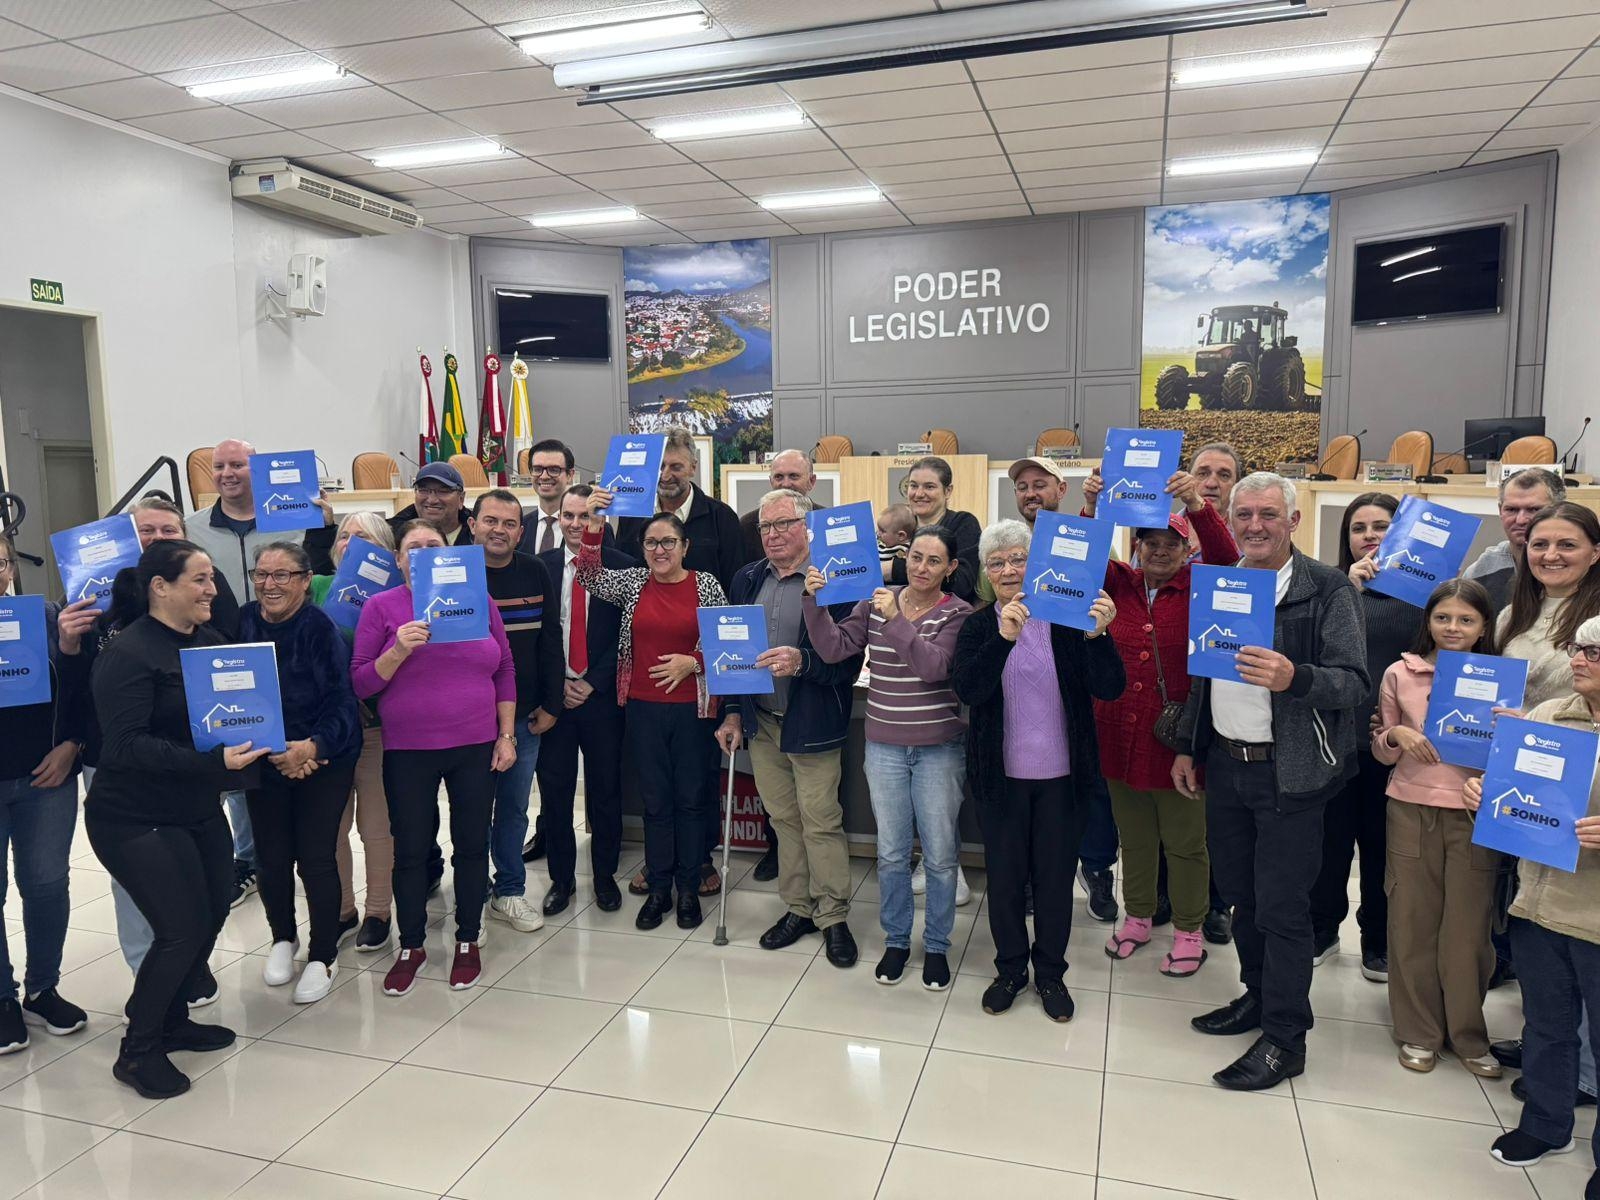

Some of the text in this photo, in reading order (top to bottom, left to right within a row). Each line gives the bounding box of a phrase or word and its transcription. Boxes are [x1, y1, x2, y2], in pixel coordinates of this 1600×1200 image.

[32, 281, 62, 301] SAÍDA
[894, 268, 1001, 303] PODER
[850, 303, 1050, 343] LEGISLATIVO
[1115, 492, 1157, 501] #SONHO
[829, 565, 867, 578] #SONHO
[1392, 561, 1436, 581] #SONHO
[1040, 582, 1085, 598] #SONHO
[433, 608, 474, 618] #SONHO
[213, 715, 265, 728] #SONHO
[1502, 805, 1560, 828] #SONHO
